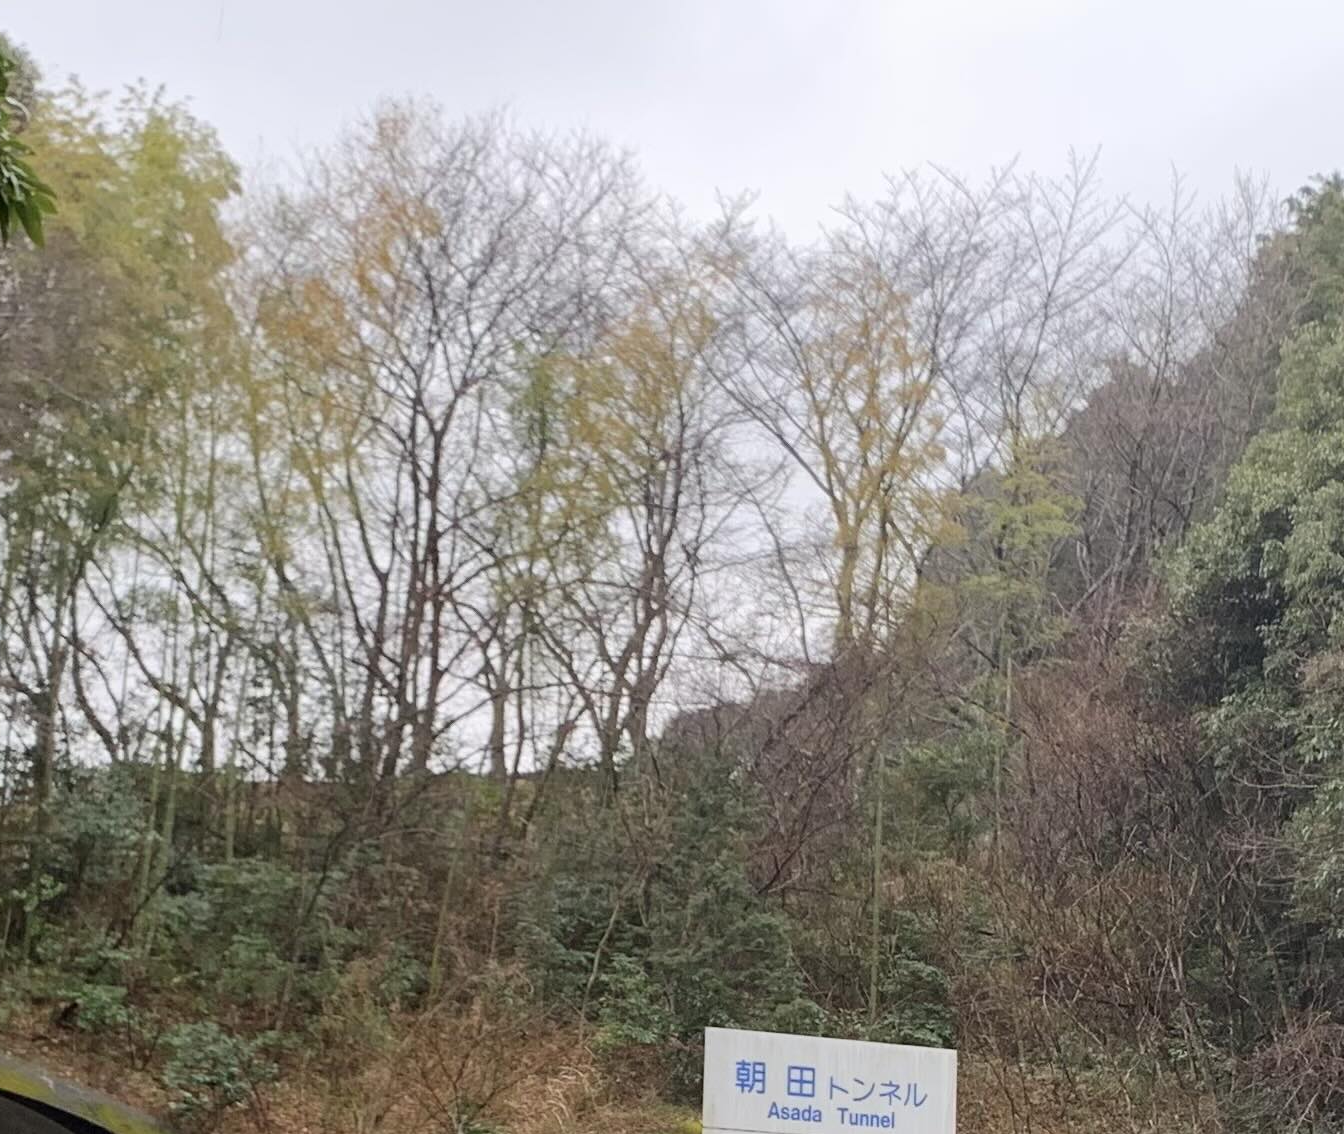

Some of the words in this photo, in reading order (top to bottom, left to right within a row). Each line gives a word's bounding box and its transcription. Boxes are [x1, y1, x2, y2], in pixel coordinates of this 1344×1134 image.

[735, 1060, 928, 1108] 朝田トンネル
[768, 1102, 822, 1123] Asada
[837, 1107, 895, 1129] Tunnel
